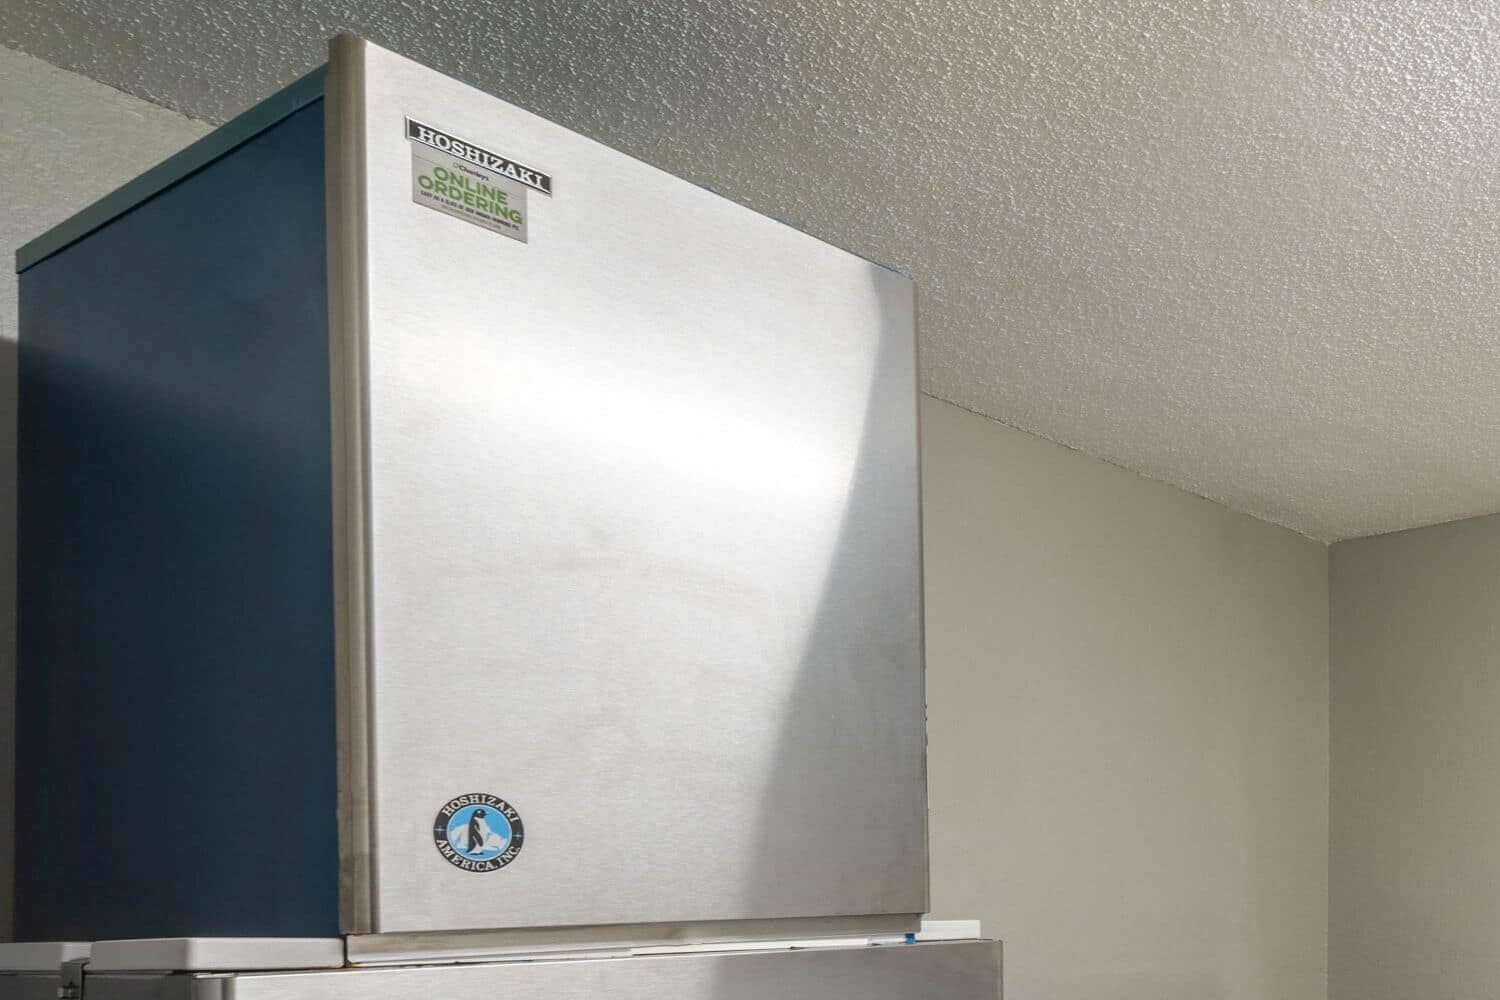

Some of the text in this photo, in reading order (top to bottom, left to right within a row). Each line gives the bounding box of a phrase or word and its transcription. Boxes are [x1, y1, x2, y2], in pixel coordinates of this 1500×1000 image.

[417, 125, 544, 188] HOSHIZAKI
[417, 174, 523, 225] ORDERING
[432, 166, 508, 206] ONLINE
[442, 794, 520, 822] HOSHIZAKI
